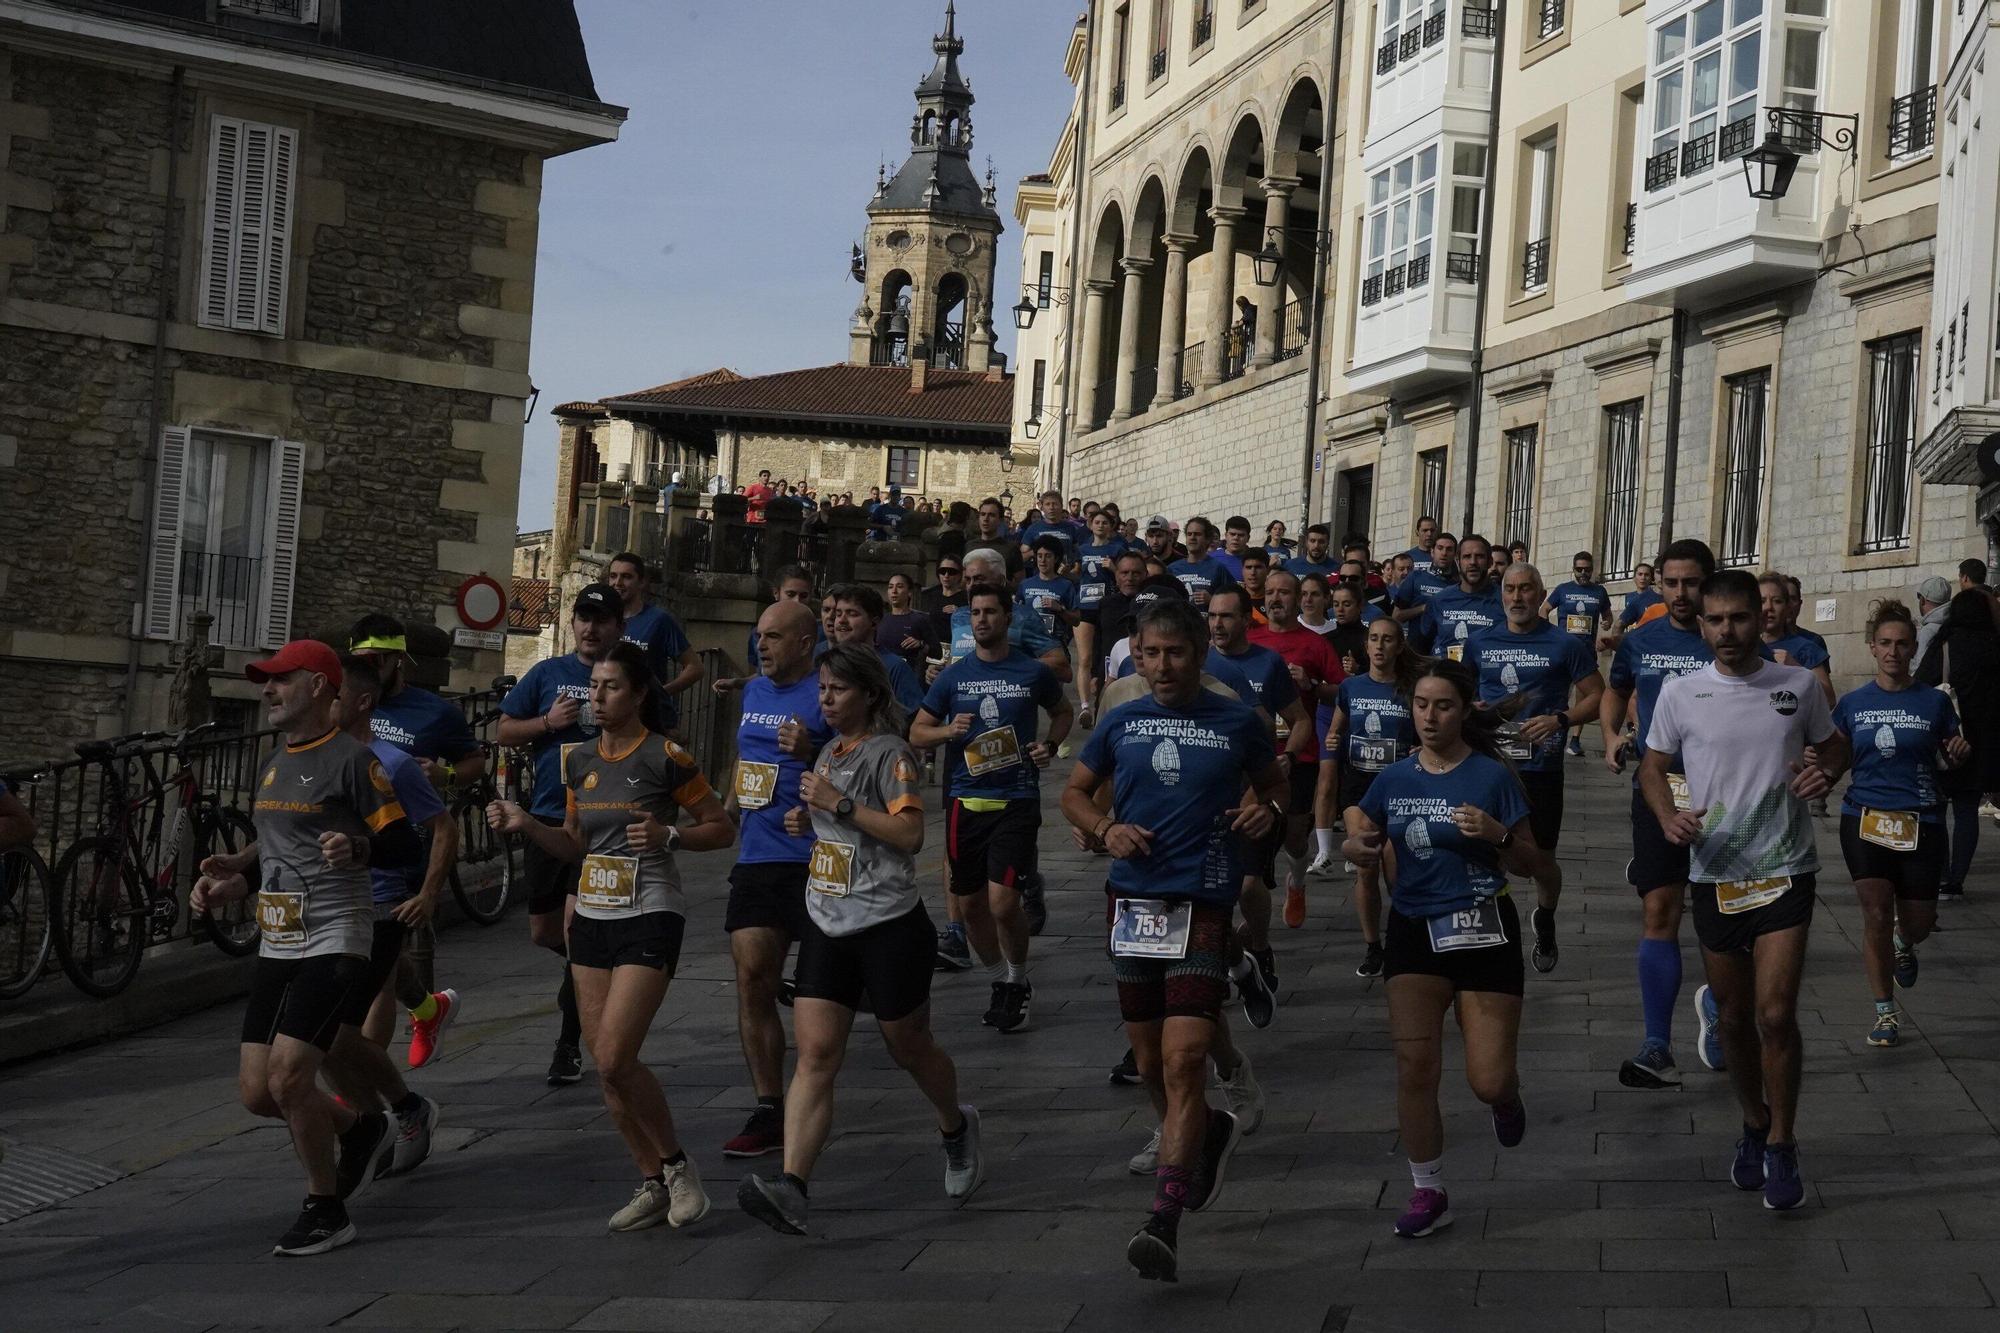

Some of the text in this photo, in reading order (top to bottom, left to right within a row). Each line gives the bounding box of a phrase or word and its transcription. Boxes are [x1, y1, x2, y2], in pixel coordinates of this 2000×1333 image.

[1490, 654, 1540, 662] ALMENDRA
[967, 680, 1006, 688] CONQUISTA
[968, 685, 1022, 695] ALMENDRA
[997, 691, 1032, 699] KONKISTA
[1863, 709, 1906, 717] CONQUISTA
[1125, 718, 1196, 729] LA CONQUISTA
[1864, 715, 1921, 724] ALMENDRA
[370, 724, 404, 736] ENDRA
[1894, 722, 1931, 732] KONKISTA
[1137, 726, 1217, 741] ALMENDRA
[980, 739, 1003, 755] 427
[1179, 737, 1231, 751] KONKISTA
[1360, 746, 1385, 761] 1073
[742, 773, 764, 792] 592
[1388, 797, 1447, 806] LA CONQUISTA
[1395, 805, 1457, 816] ALMENDR
[1876, 818, 1904, 836] 434
[588, 867, 619, 890] 596
[262, 906, 287, 926] 402
[1135, 914, 1168, 937] 753
